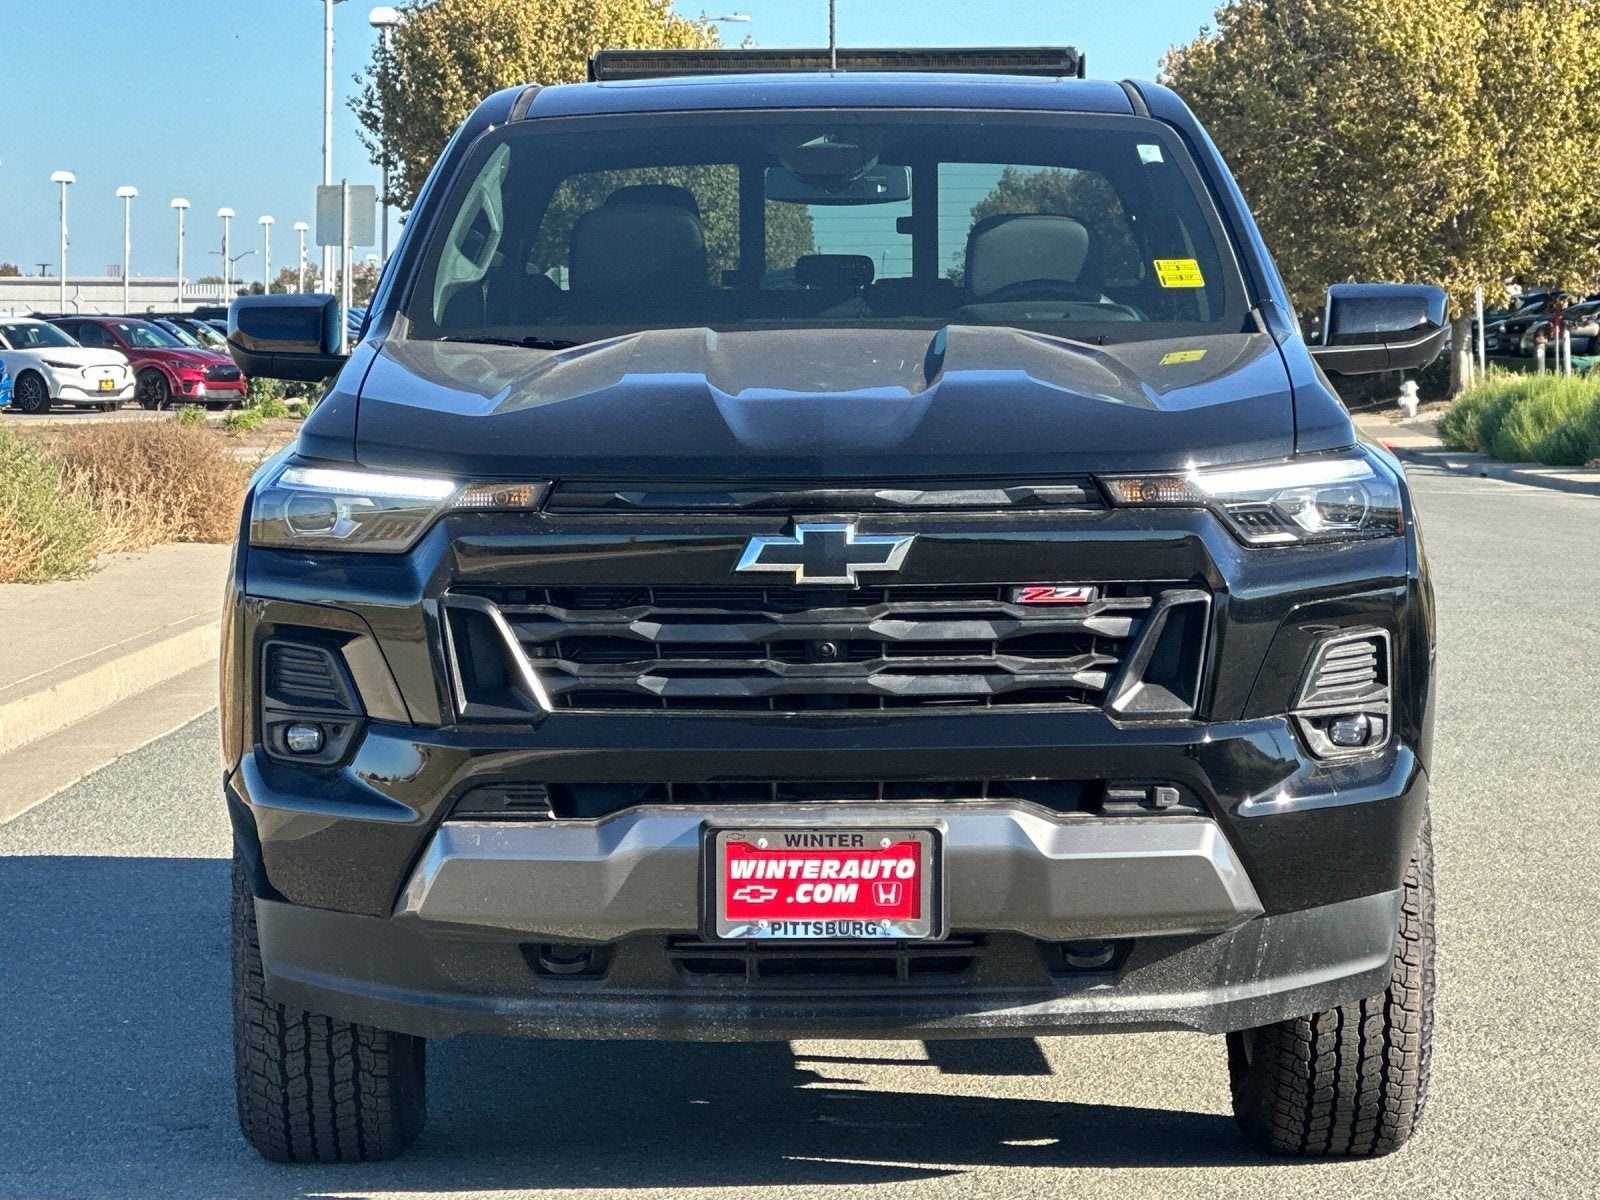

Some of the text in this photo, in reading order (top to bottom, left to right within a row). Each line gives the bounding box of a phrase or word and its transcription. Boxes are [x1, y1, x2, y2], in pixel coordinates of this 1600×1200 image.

[1016, 586, 1093, 603] Z71
[784, 833, 865, 847] WINTER
[730, 859, 916, 880] WINTERAUTO
[786, 883, 859, 904] .COM
[770, 921, 878, 937] PITTSBURG
